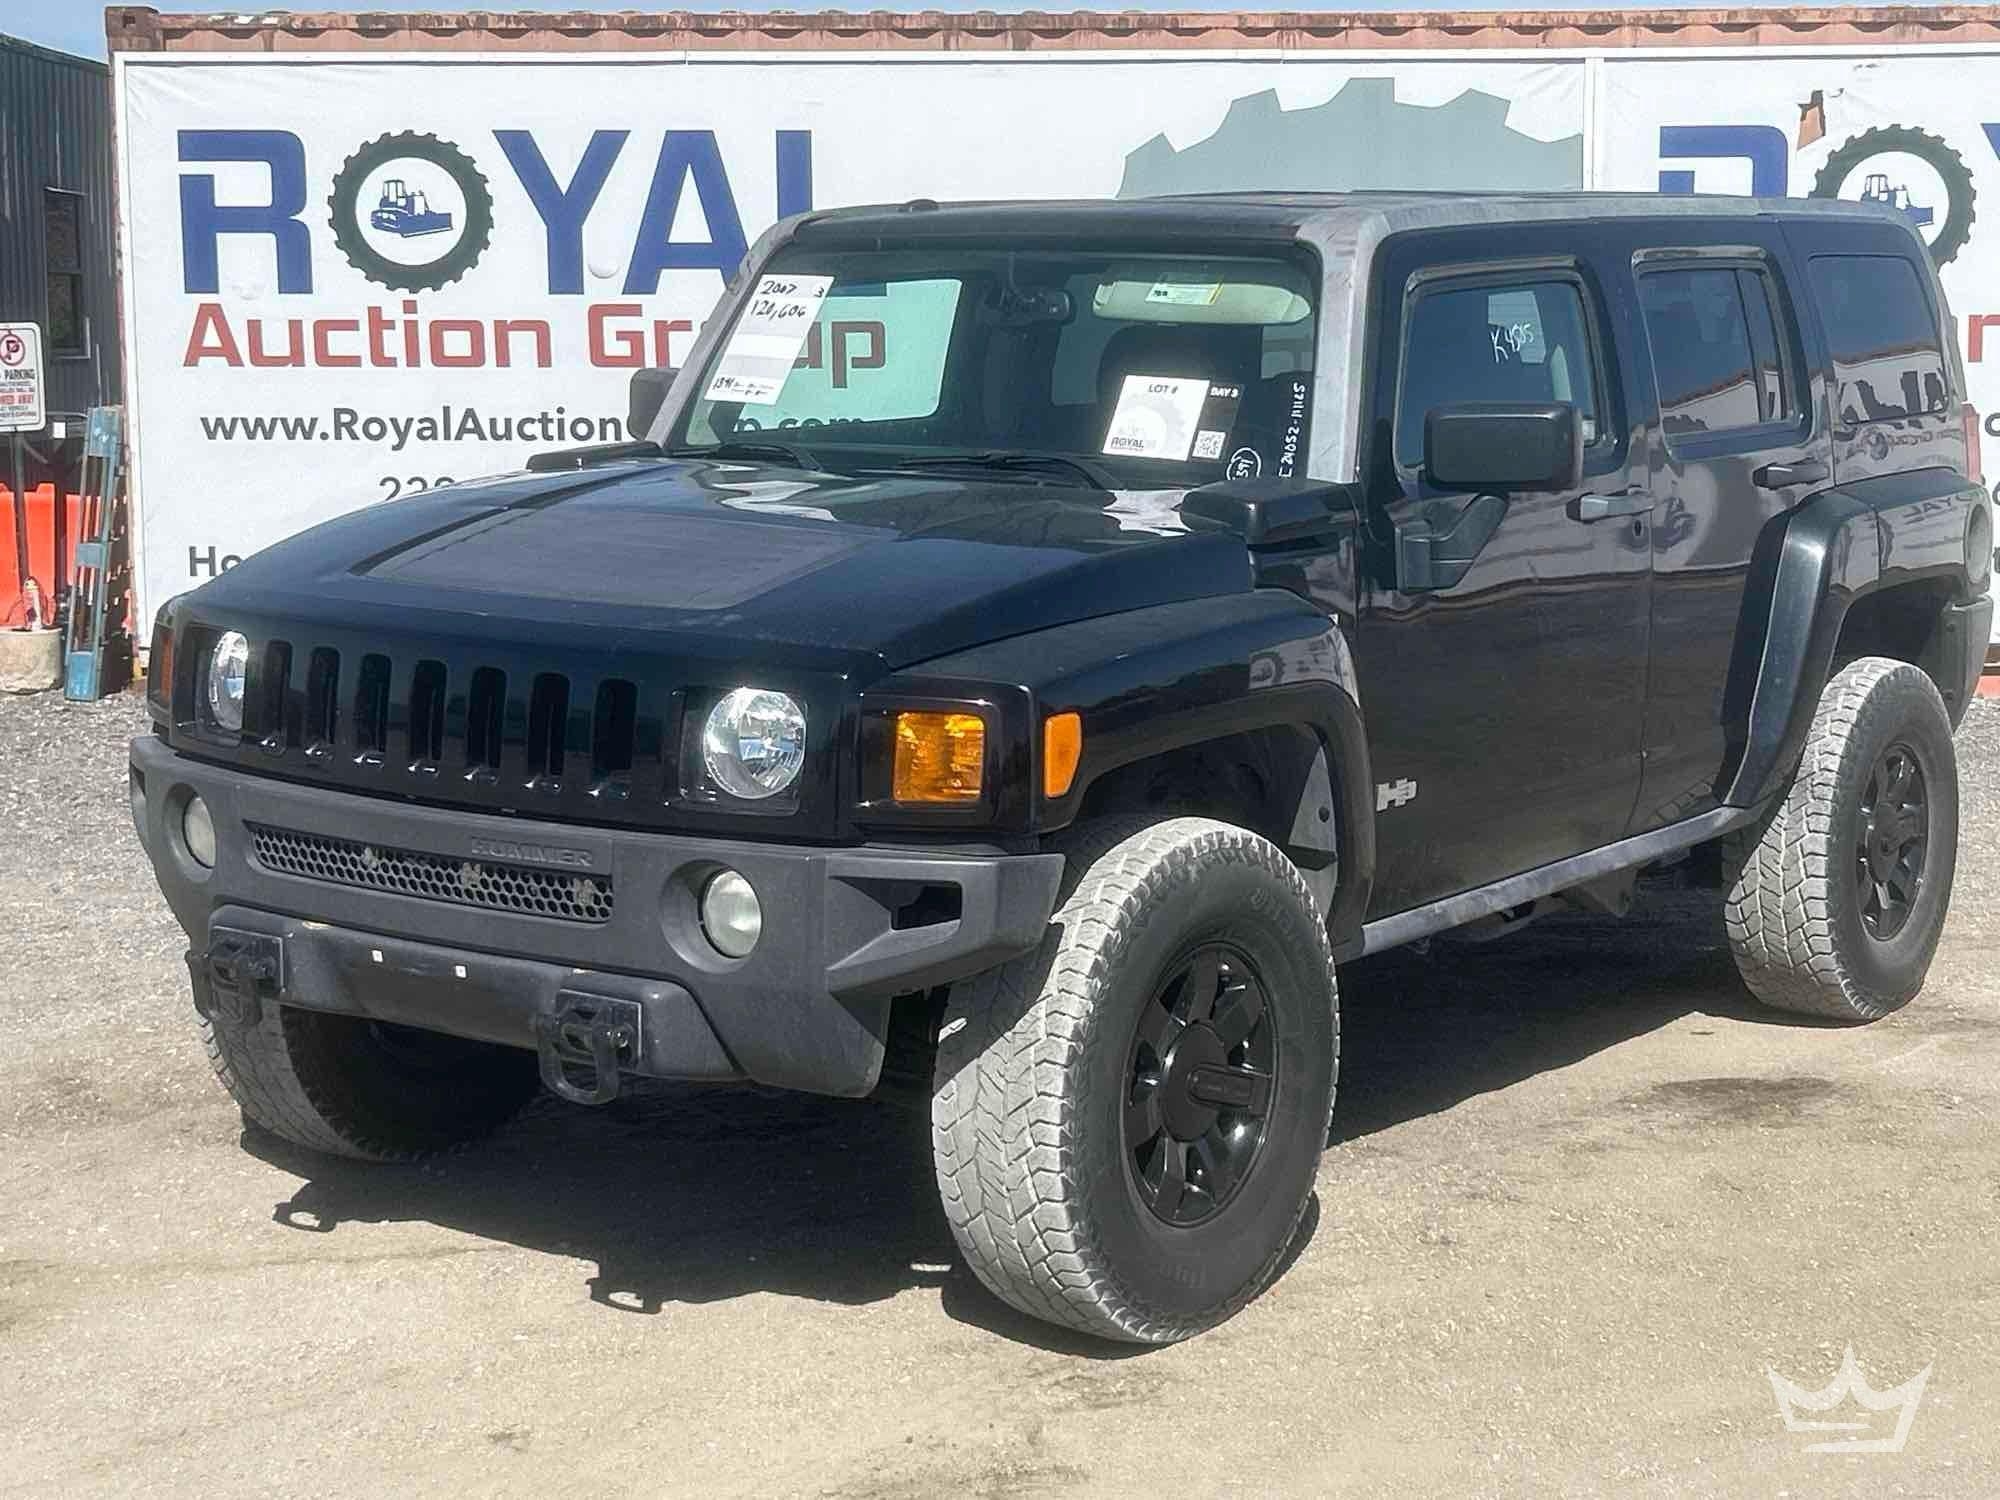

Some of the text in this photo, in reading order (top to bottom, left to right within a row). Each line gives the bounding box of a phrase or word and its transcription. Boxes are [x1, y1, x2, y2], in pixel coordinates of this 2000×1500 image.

[760, 280, 798, 295] 2007
[183, 300, 887, 389] Auction Grp
[1148, 384, 1169, 394] LOT
[1210, 386, 1231, 398] DAY
